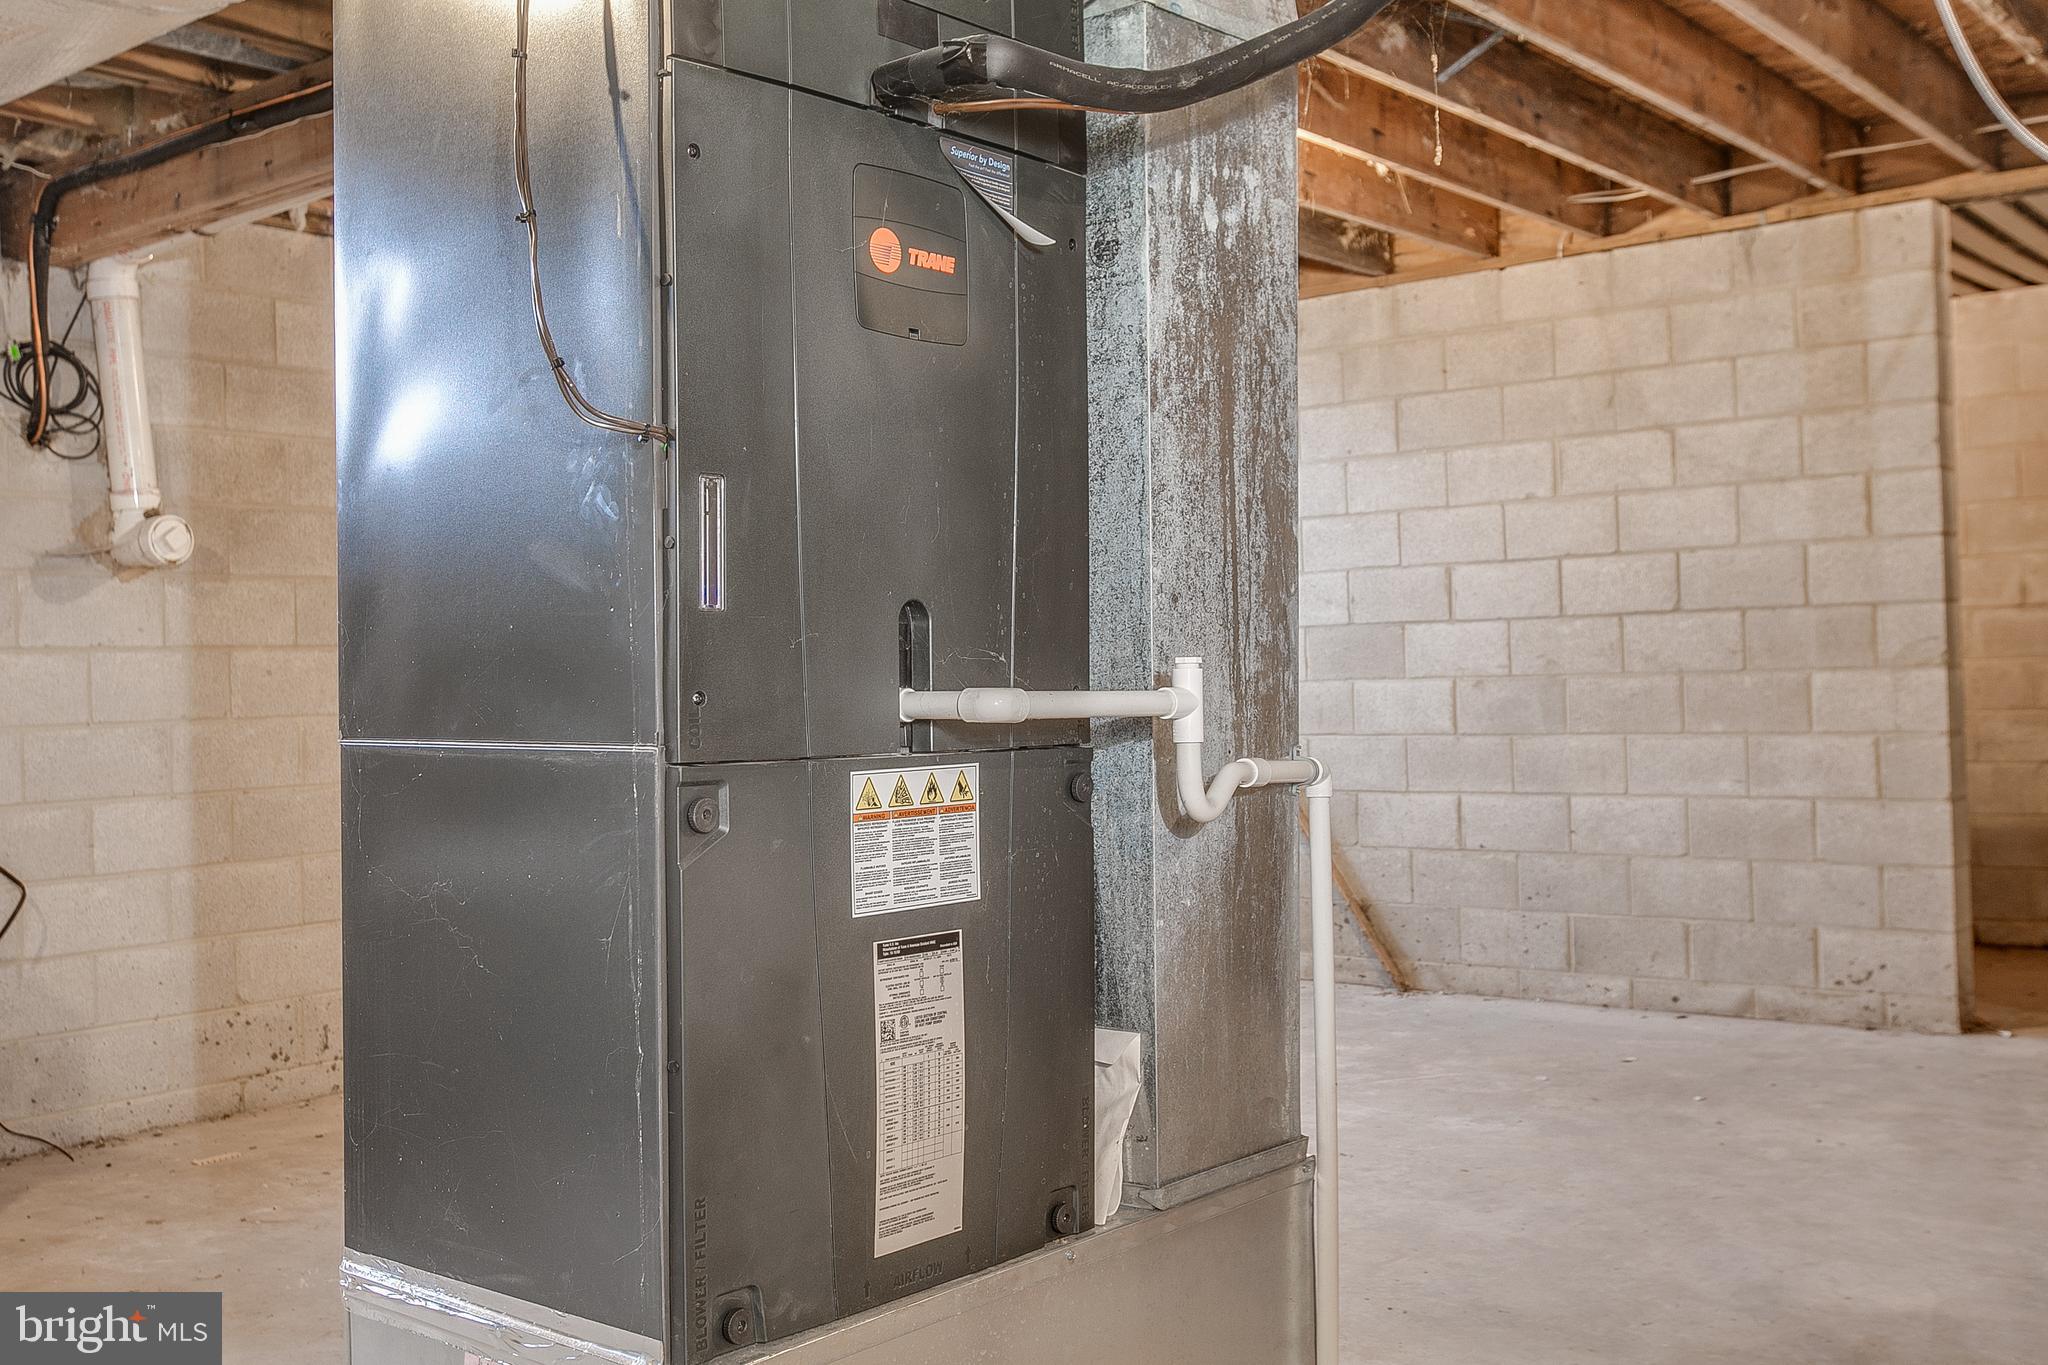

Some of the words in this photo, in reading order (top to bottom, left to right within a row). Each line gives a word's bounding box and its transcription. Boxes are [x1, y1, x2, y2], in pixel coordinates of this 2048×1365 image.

[1049, 61, 1101, 83] ARMACELL
[950, 146, 978, 161] Superior
[979, 154, 988, 167] by
[988, 157, 1011, 172] Design
[908, 248, 956, 275] TRANE
[861, 813, 886, 821] WARNING
[898, 808, 936, 817] AVERTISSEMENT
[944, 804, 975, 813] ADVERTENCIA
[694, 1197, 707, 1261] FILTER
[893, 1261, 944, 1290] AIRFLOW
[695, 1274, 708, 1350] BLOWER
